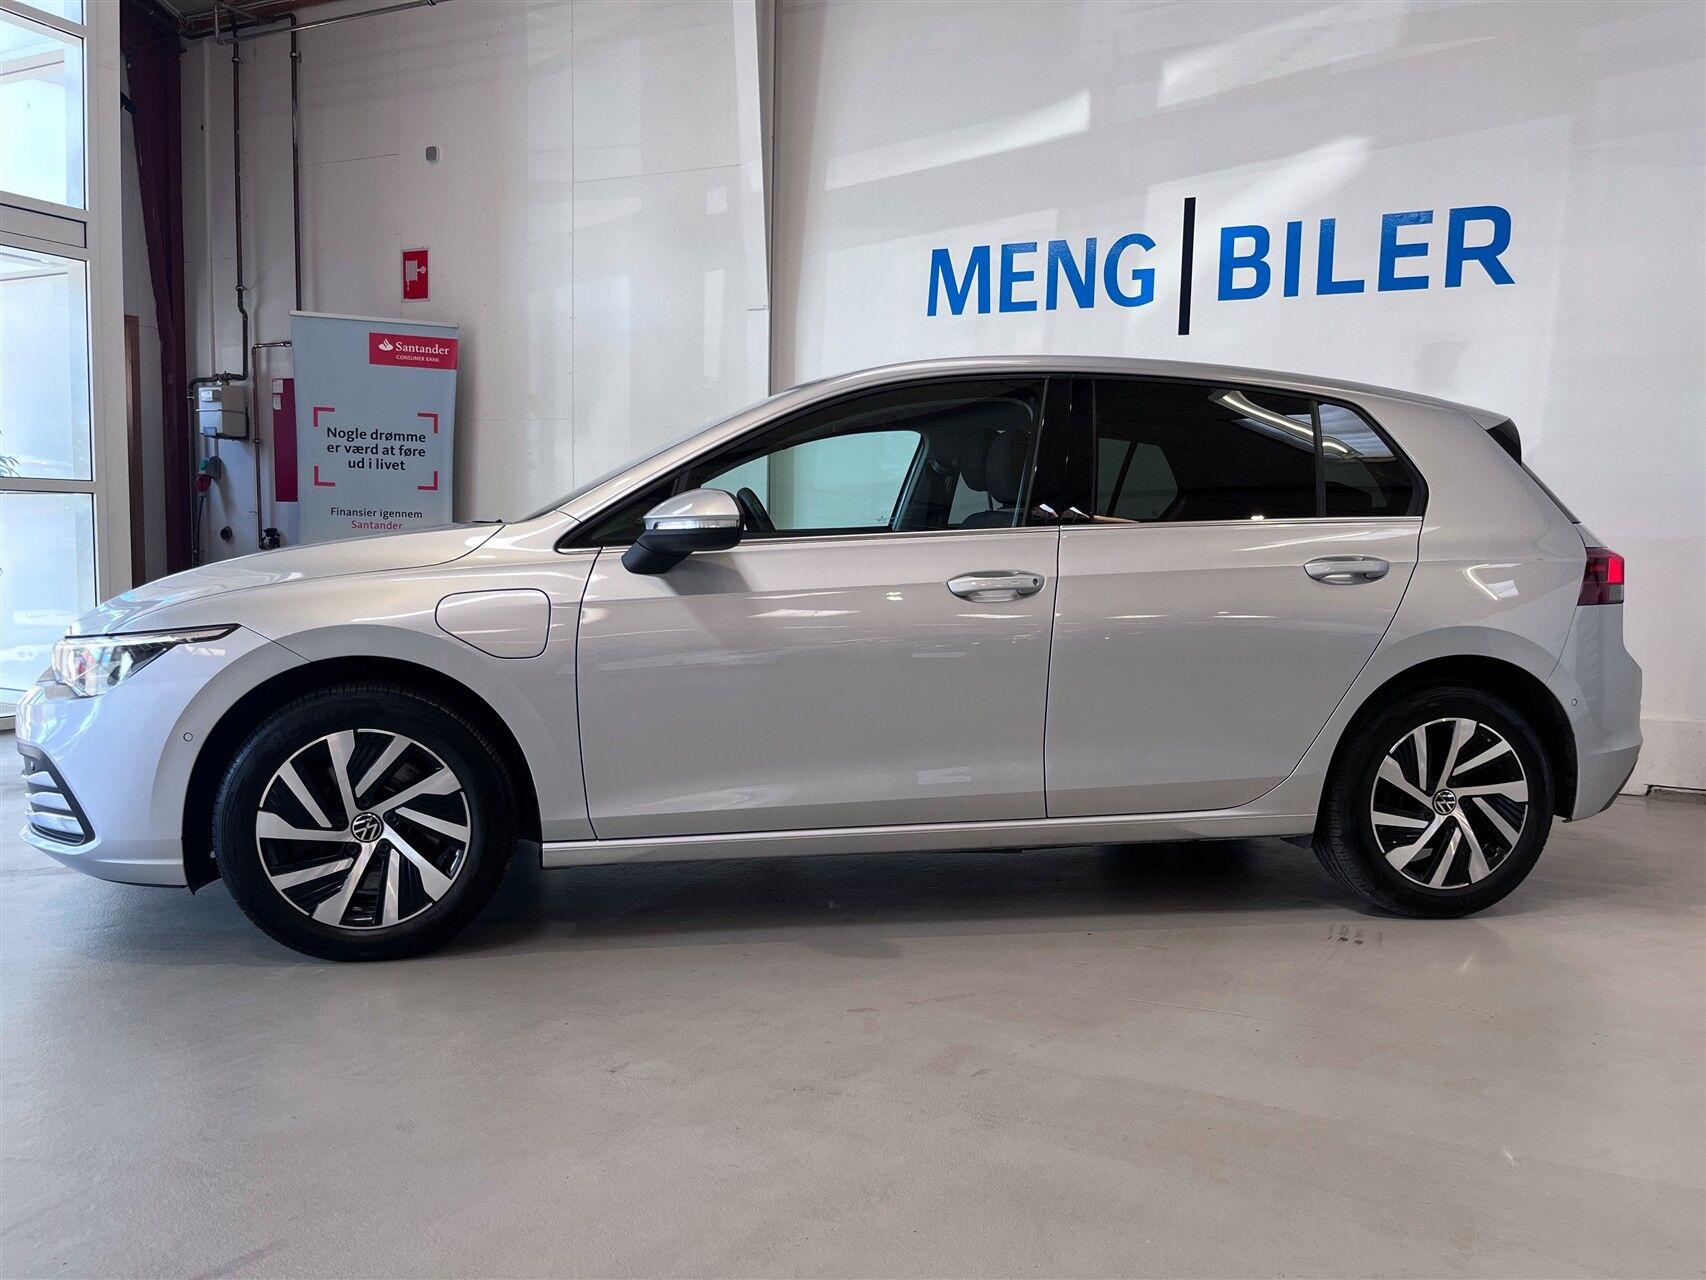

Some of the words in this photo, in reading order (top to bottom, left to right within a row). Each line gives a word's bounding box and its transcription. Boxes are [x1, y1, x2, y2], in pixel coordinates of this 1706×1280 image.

[926, 232, 1156, 316] MENG
[1217, 205, 1516, 301] BILER
[395, 341, 450, 355] Santander
[396, 354, 425, 362] CONSUMER
[327, 427, 367, 442] Nogle
[370, 429, 426, 443] drømme
[327, 443, 341, 453] er
[344, 443, 379, 455] værd
[382, 445, 396, 456] at
[399, 445, 426, 457] føre
[348, 458, 365, 469] ud
[368, 458, 372, 469] i
[376, 458, 406, 471] livet
[330, 507, 377, 517] Finansier
[380, 508, 423, 519] igennem
[351, 520, 403, 530] Santander
